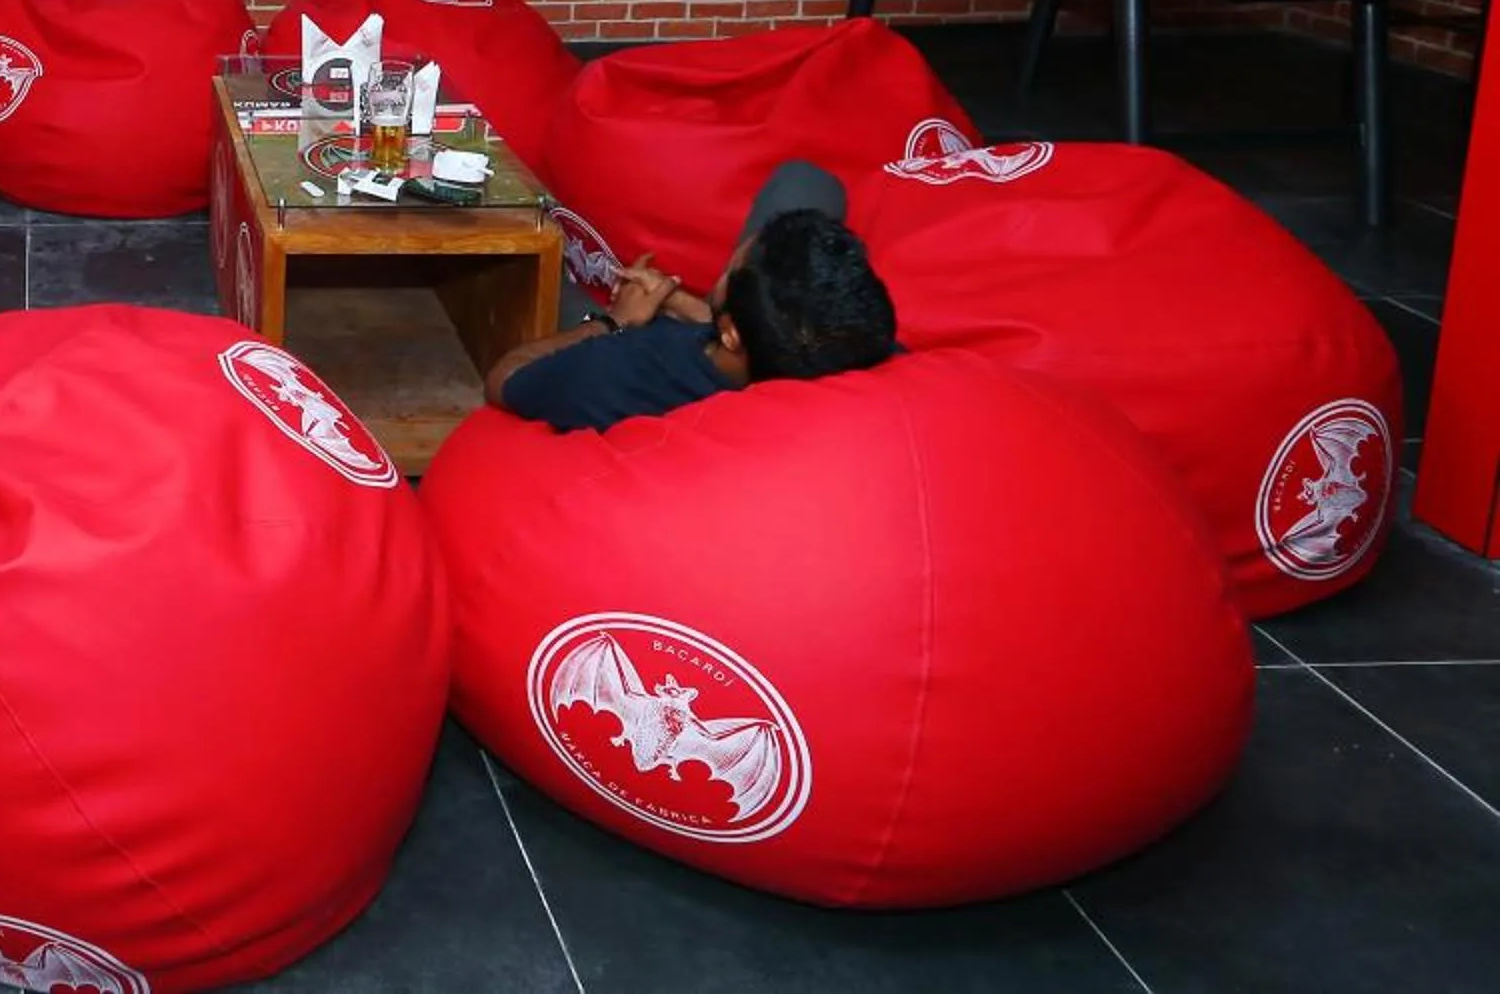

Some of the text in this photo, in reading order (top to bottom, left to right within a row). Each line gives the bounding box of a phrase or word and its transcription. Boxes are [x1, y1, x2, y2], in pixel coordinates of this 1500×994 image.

[652, 639, 735, 688] BACARDI
[608, 781, 628, 800] DE
[634, 794, 715, 826] FABRICA
